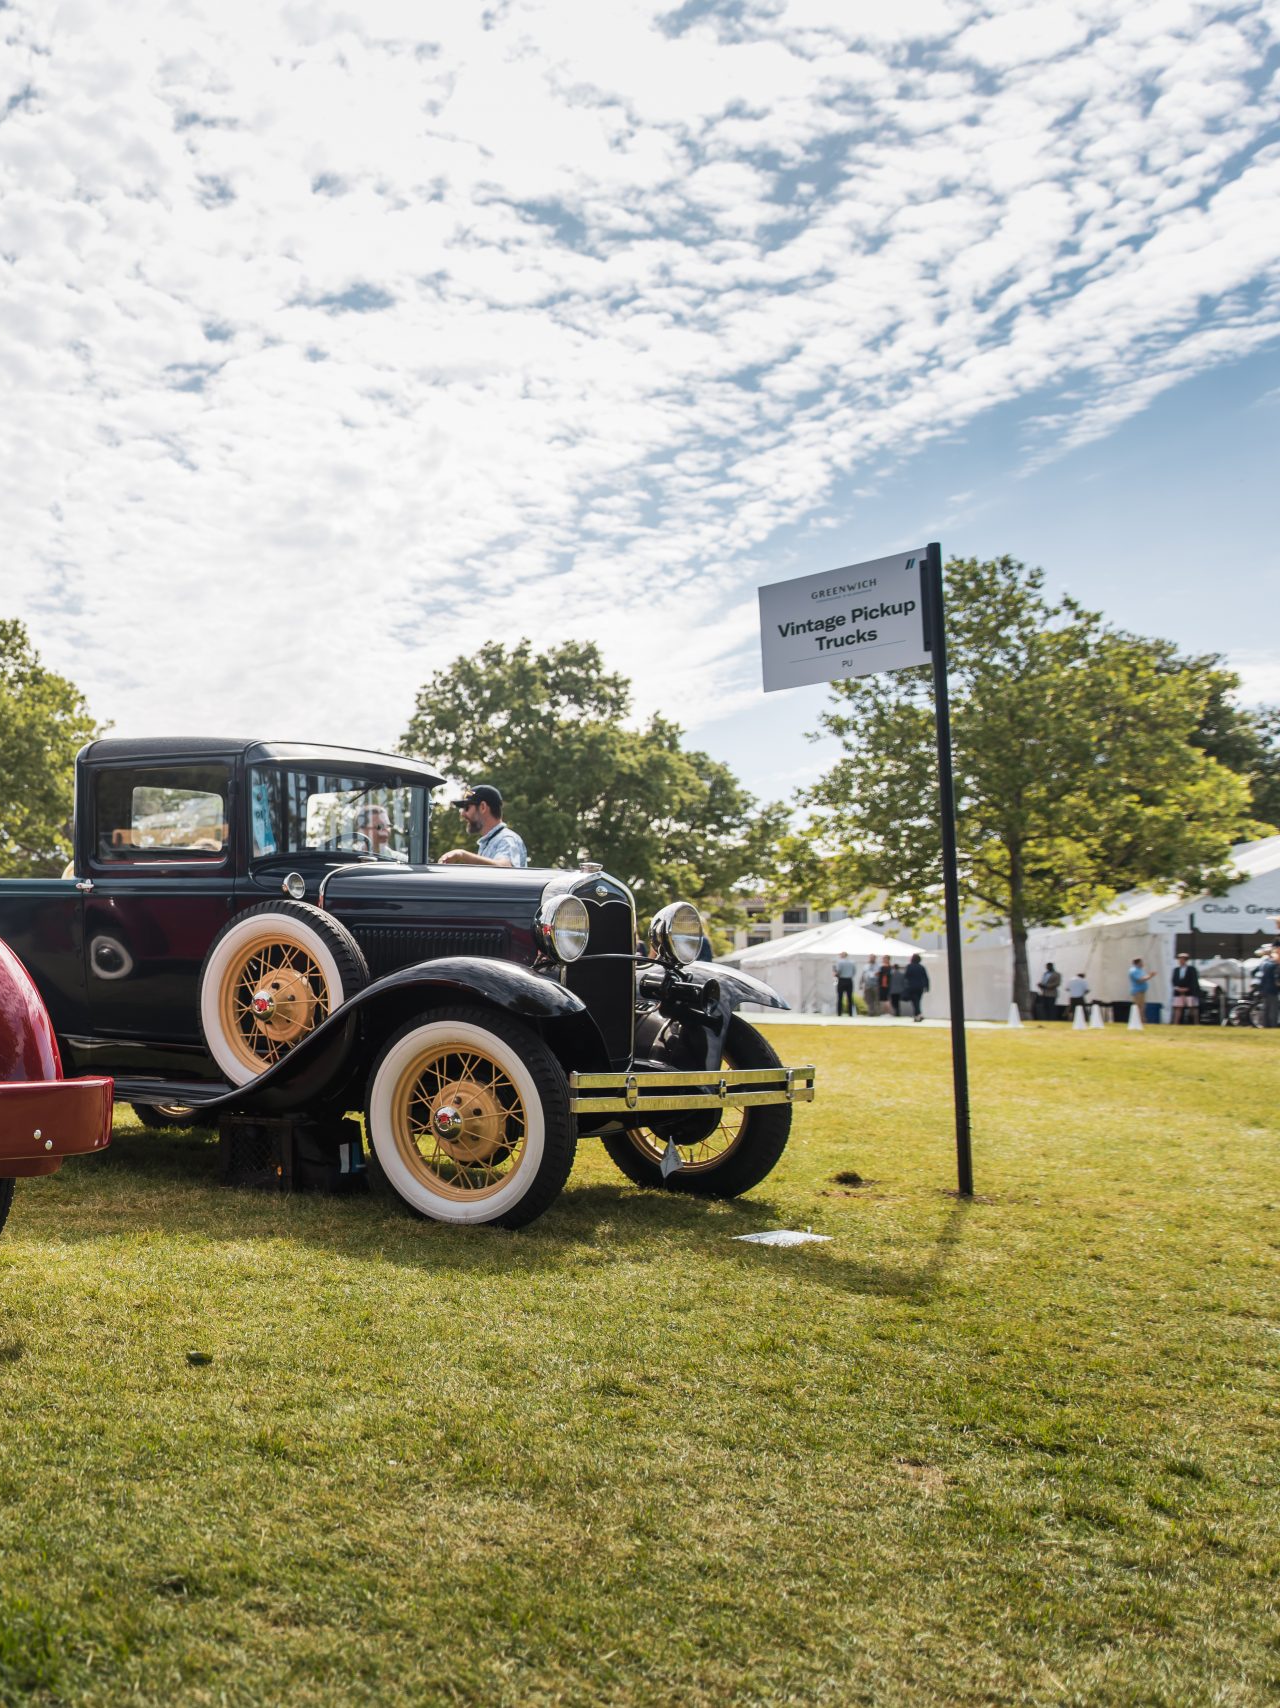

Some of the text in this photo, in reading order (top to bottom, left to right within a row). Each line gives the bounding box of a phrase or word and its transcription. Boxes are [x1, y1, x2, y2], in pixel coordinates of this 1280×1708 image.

[810, 578, 877, 600] GREENWICH
[777, 599, 916, 638] Vintage Pickup
[815, 628, 878, 651] Trucks
[841, 659, 853, 668] PU
[1202, 903, 1239, 914] Club
